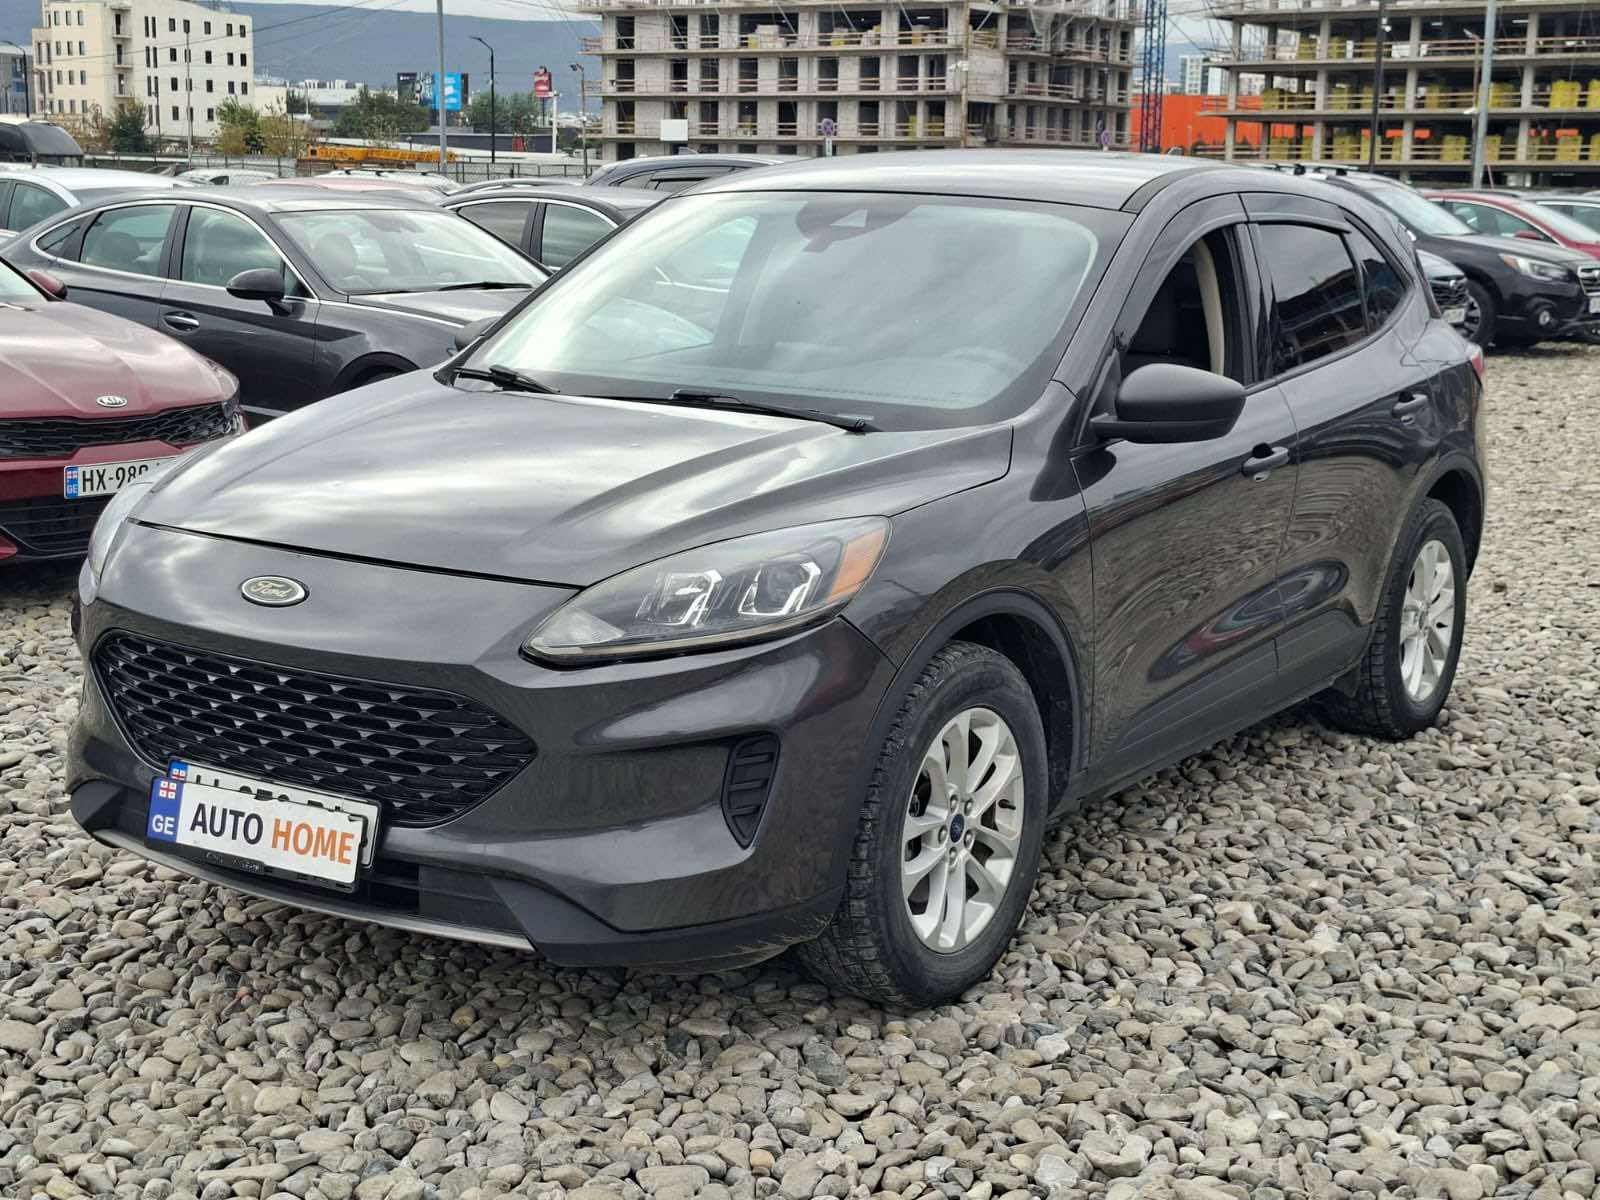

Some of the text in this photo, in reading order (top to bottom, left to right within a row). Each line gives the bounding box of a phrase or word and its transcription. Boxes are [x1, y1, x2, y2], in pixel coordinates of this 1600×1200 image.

[250, 580, 293, 598] Ford
[152, 814, 175, 836] GE
[190, 803, 264, 845] AUTO
[271, 818, 355, 865] HOME
